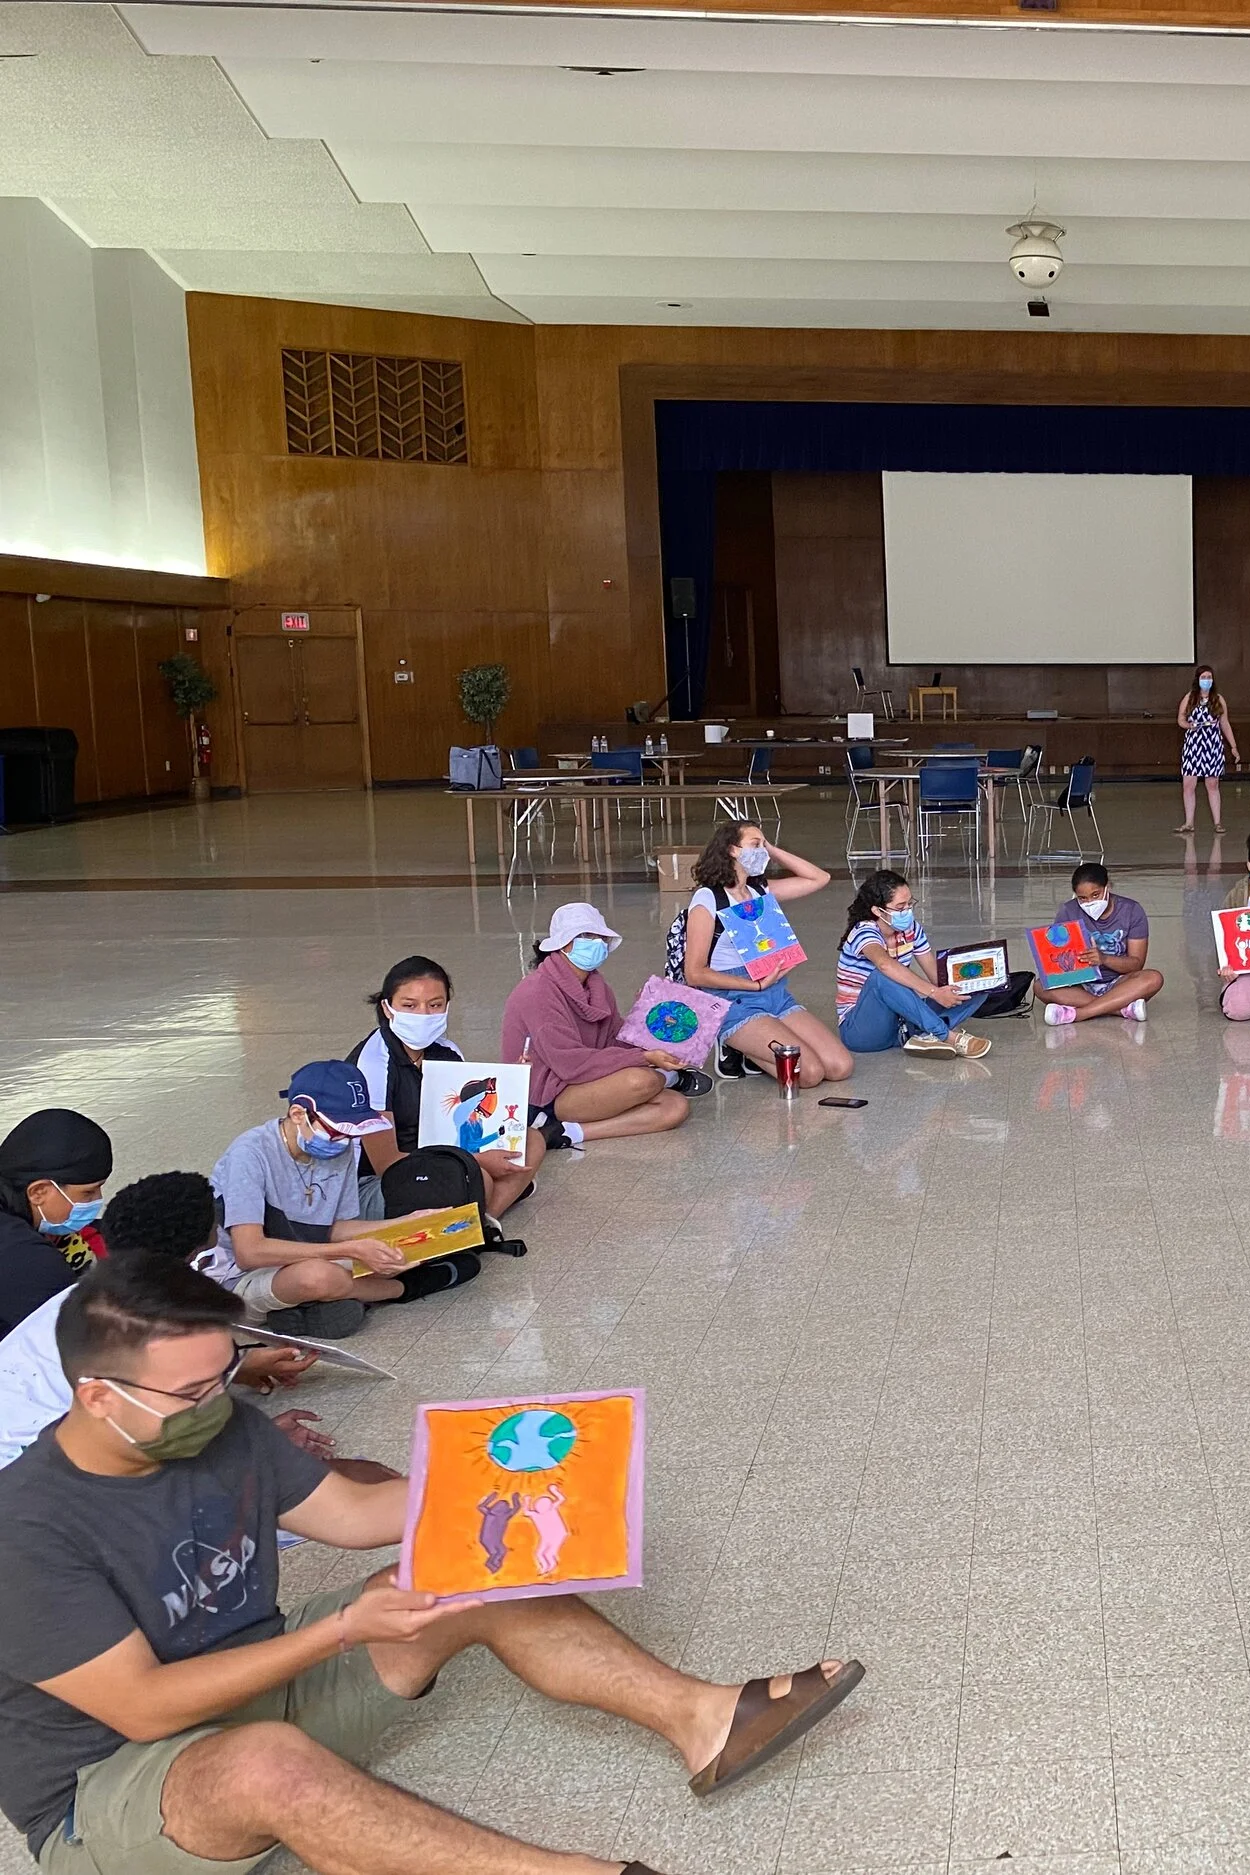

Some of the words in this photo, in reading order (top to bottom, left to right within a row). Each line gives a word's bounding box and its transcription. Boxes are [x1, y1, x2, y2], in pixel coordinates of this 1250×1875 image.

[285, 615, 306, 628] EXIT
[346, 1081, 366, 1107] B
[161, 1534, 256, 1628] NASA
